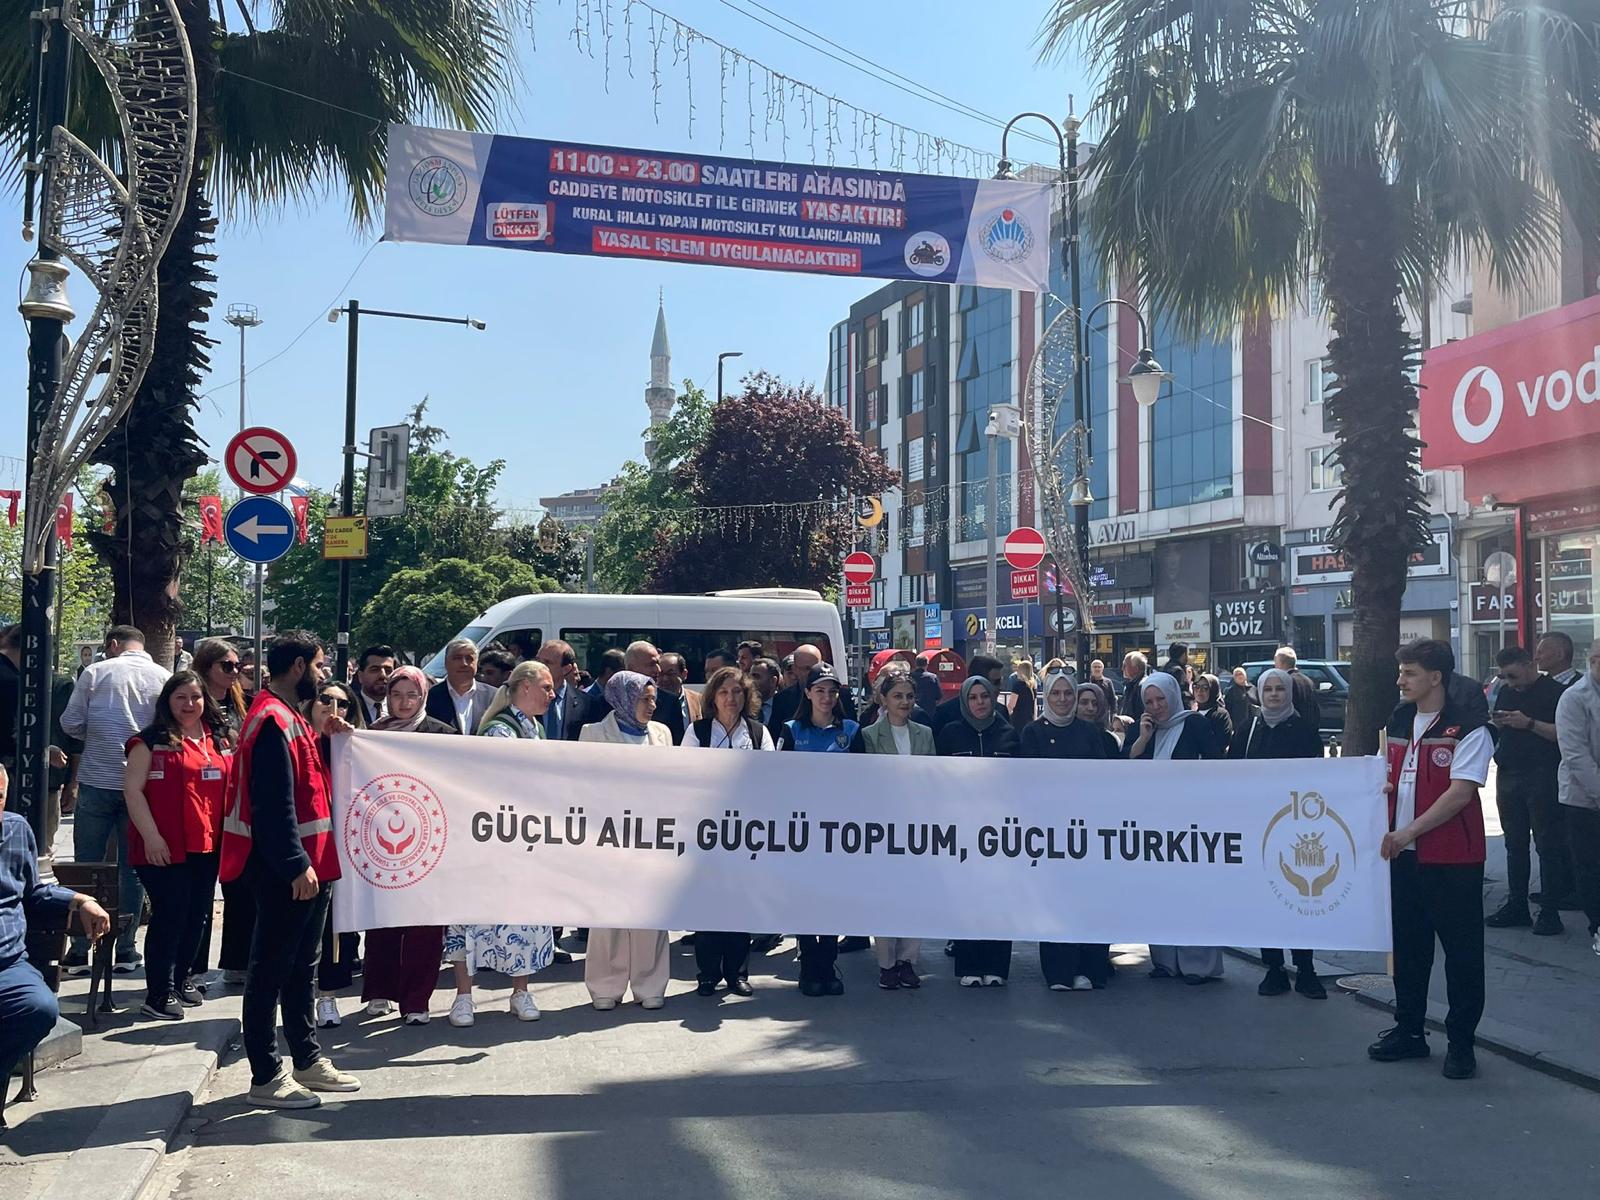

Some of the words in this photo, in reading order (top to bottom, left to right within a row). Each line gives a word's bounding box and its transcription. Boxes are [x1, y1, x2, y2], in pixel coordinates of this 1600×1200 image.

[553, 150, 614, 175] 11.00
[635, 158, 696, 184] 23.00
[701, 164, 798, 193] SAATLERİ
[803, 174, 907, 203] ARASINDA
[494, 207, 539, 220] LÜTFEN
[549, 179, 617, 200] CADDEYE
[621, 186, 713, 209] MOTOSİKLET
[716, 195, 738, 211] İLE
[805, 201, 902, 228] YASAKTIR!
[494, 223, 539, 236] DİKKAT
[572, 206, 614, 222] KURAL
[616, 210, 656, 226] İHLALİ
[659, 214, 698, 229] YAPAN
[701, 217, 776, 237] MOTOSİKLET
[778, 224, 881, 246] KULLANICILARINA
[598, 230, 651, 250] YASAL
[655, 237, 705, 257] İŞLEM
[709, 242, 857, 268] UYGULANACAKTIR!
[1097, 520, 1135, 543] AVM
[1013, 574, 1035, 584] DİKKAT
[1226, 601, 1256, 616] VEYS
[978, 615, 1023, 631] TKCELL
[1219, 616, 1263, 636] DÖVİZ
[21, 634, 39, 820] BELEDİYES
[471, 804, 588, 852] GÜÇLÜ
[596, 809, 686, 857] AİLE,
[696, 810, 810, 860] GÜÇLÜ
[819, 821, 968, 864] TOPLUM,
[977, 817, 1088, 867] GÜÇLÜ
[1097, 820, 1243, 864] TÜRKİYE
